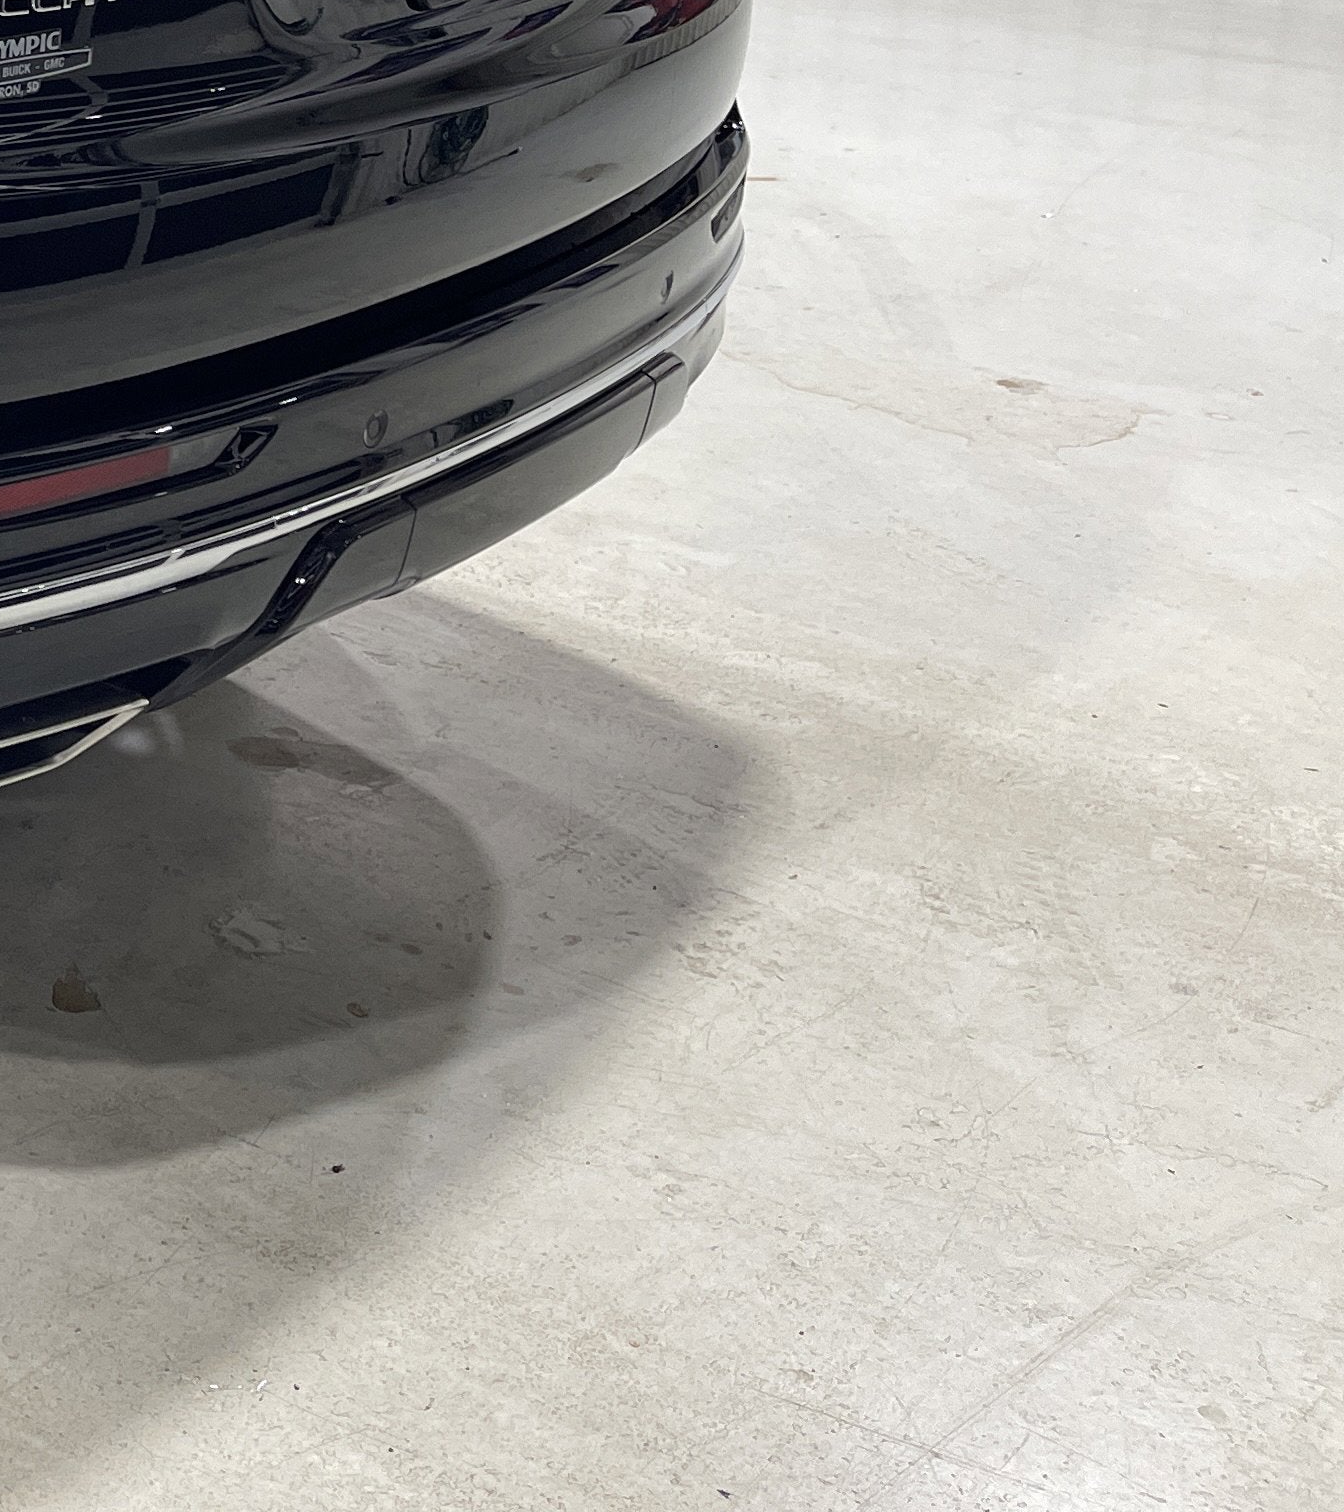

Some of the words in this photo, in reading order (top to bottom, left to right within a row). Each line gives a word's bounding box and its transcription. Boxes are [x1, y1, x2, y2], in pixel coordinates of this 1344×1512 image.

[2, 62, 32, 79] BUICK
[44, 56, 65, 72] GMC
[26, 80, 41, 94] SD
